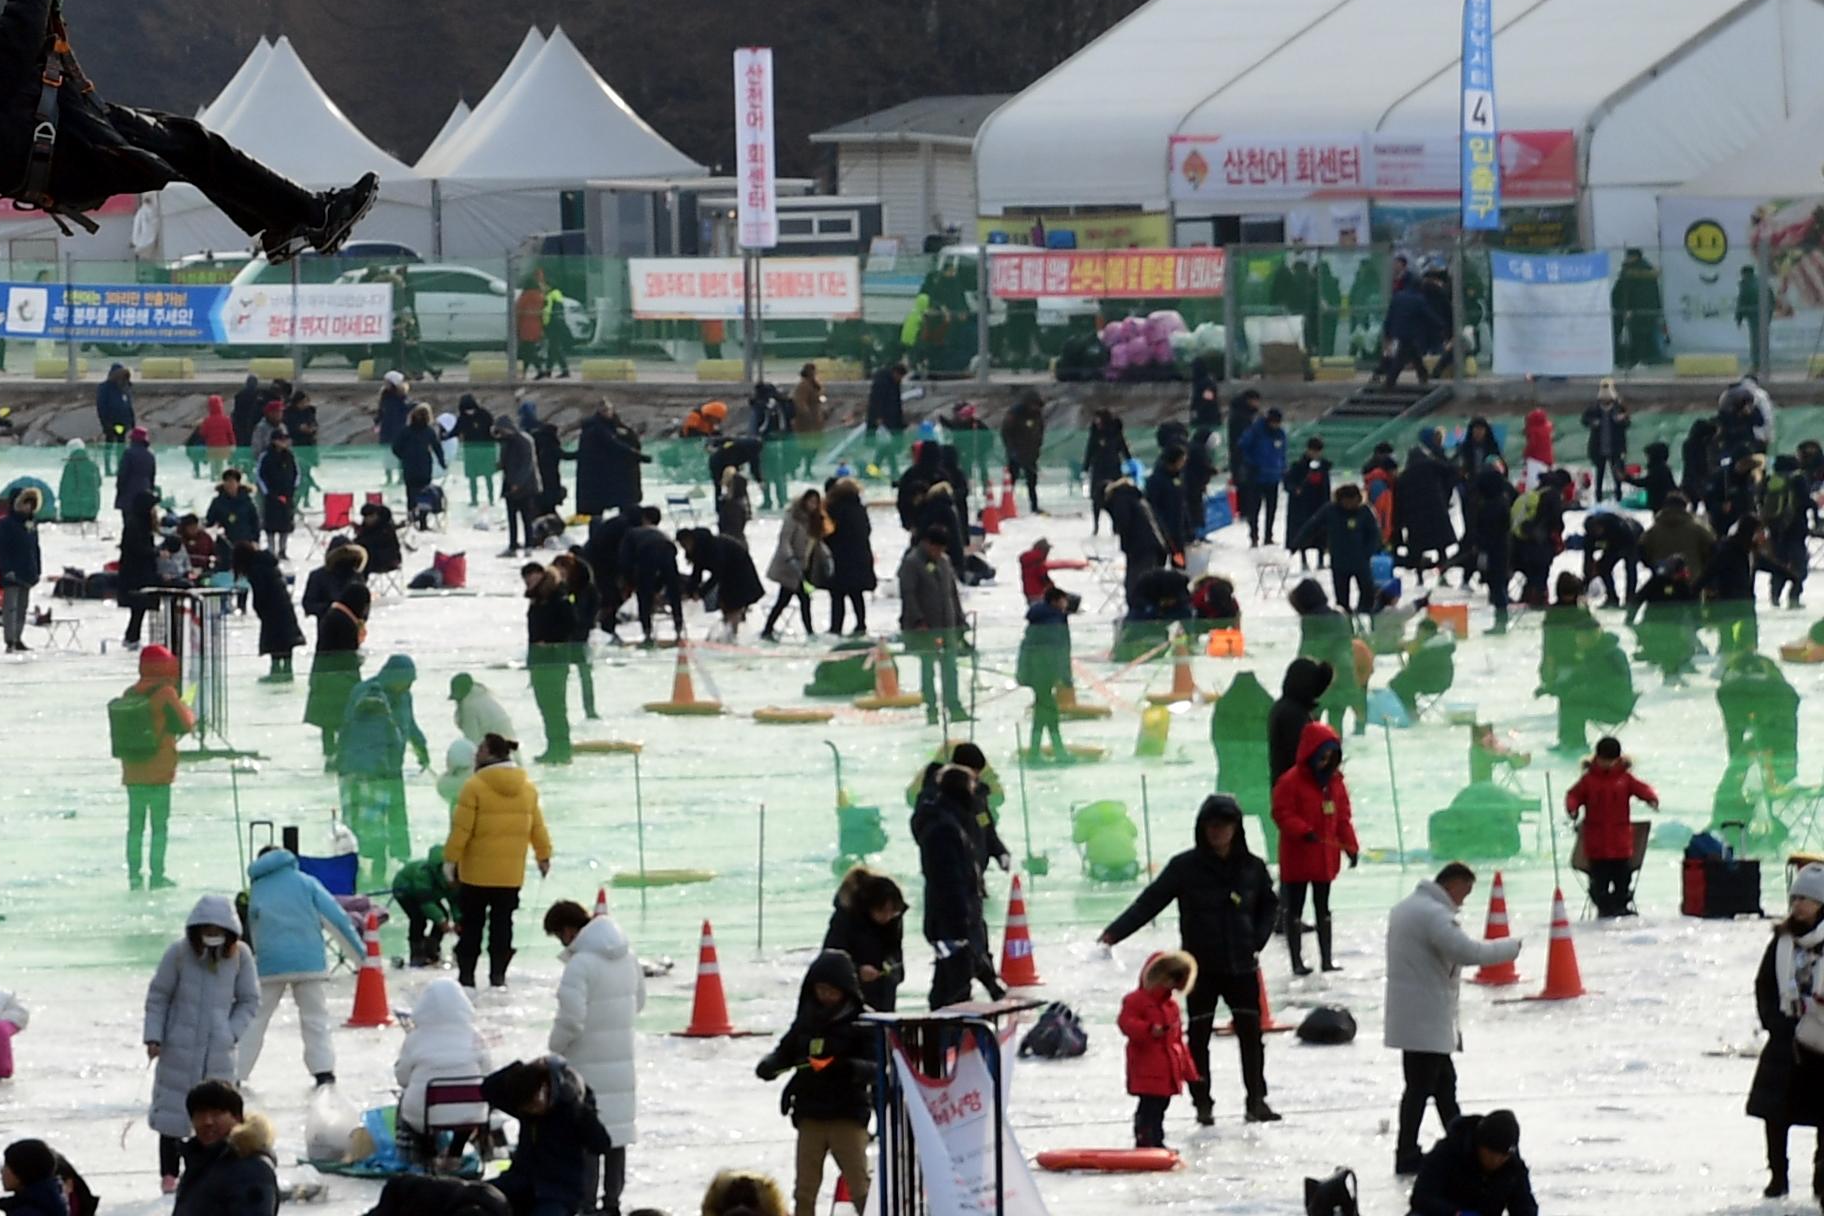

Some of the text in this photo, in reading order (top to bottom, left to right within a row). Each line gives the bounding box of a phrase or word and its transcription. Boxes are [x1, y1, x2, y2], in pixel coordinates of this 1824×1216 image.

[745, 64, 765, 132] 산천어
[1472, 95, 1486, 127] 4
[747, 143, 767, 212] 회센터
[1222, 145, 1362, 185] 산천어 회센터
[112, 307, 149, 326] 사용해
[152, 307, 194, 326] 주세요!
[267, 314, 295, 336] 절대
[332, 314, 383, 336] 마세요!
